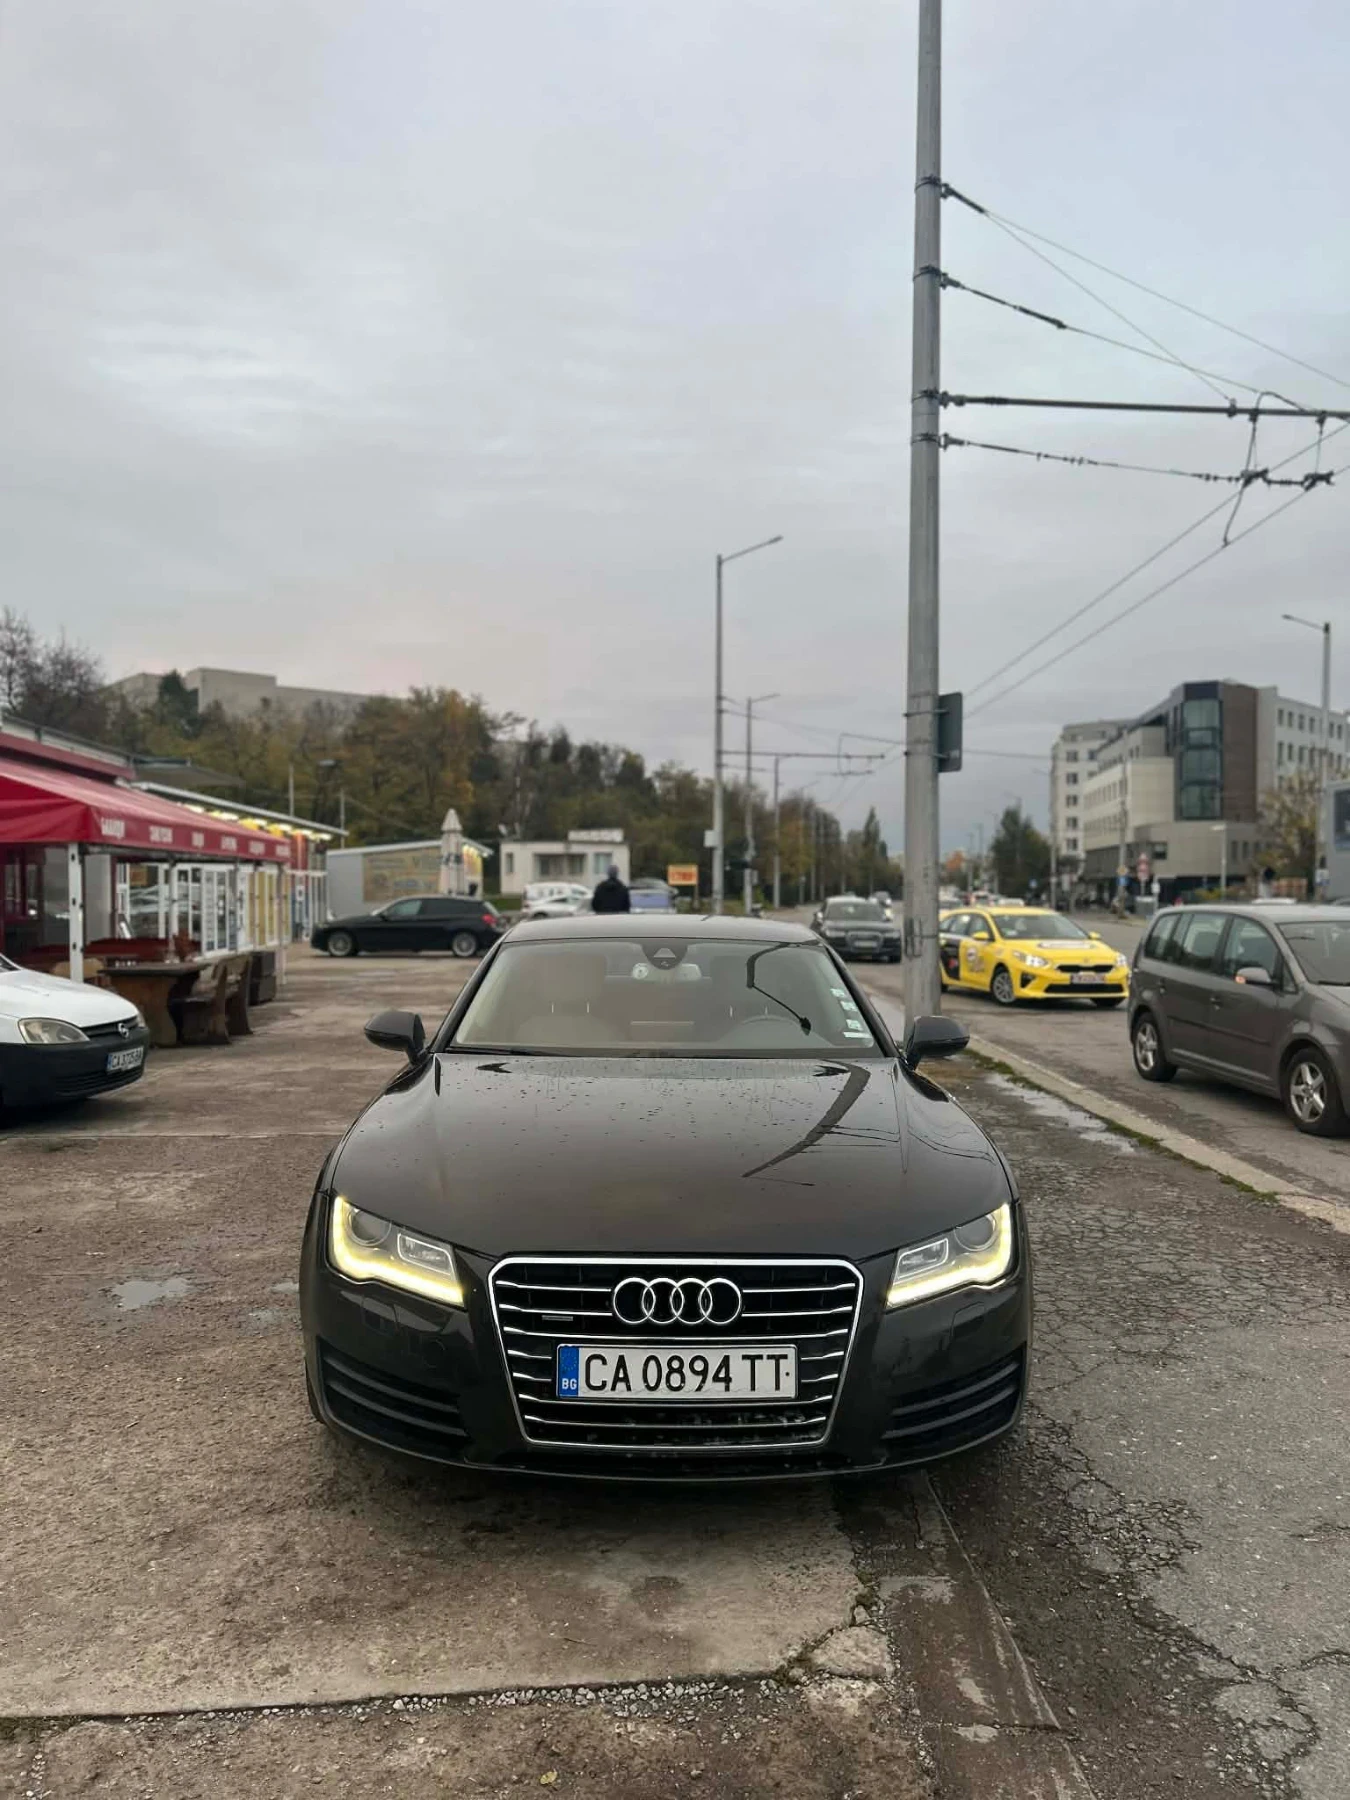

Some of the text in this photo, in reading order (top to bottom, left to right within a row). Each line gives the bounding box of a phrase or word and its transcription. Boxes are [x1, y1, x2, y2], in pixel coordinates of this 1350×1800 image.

[561, 1378, 577, 1390] BG
[584, 1353, 788, 1392] CA 0894 TT
